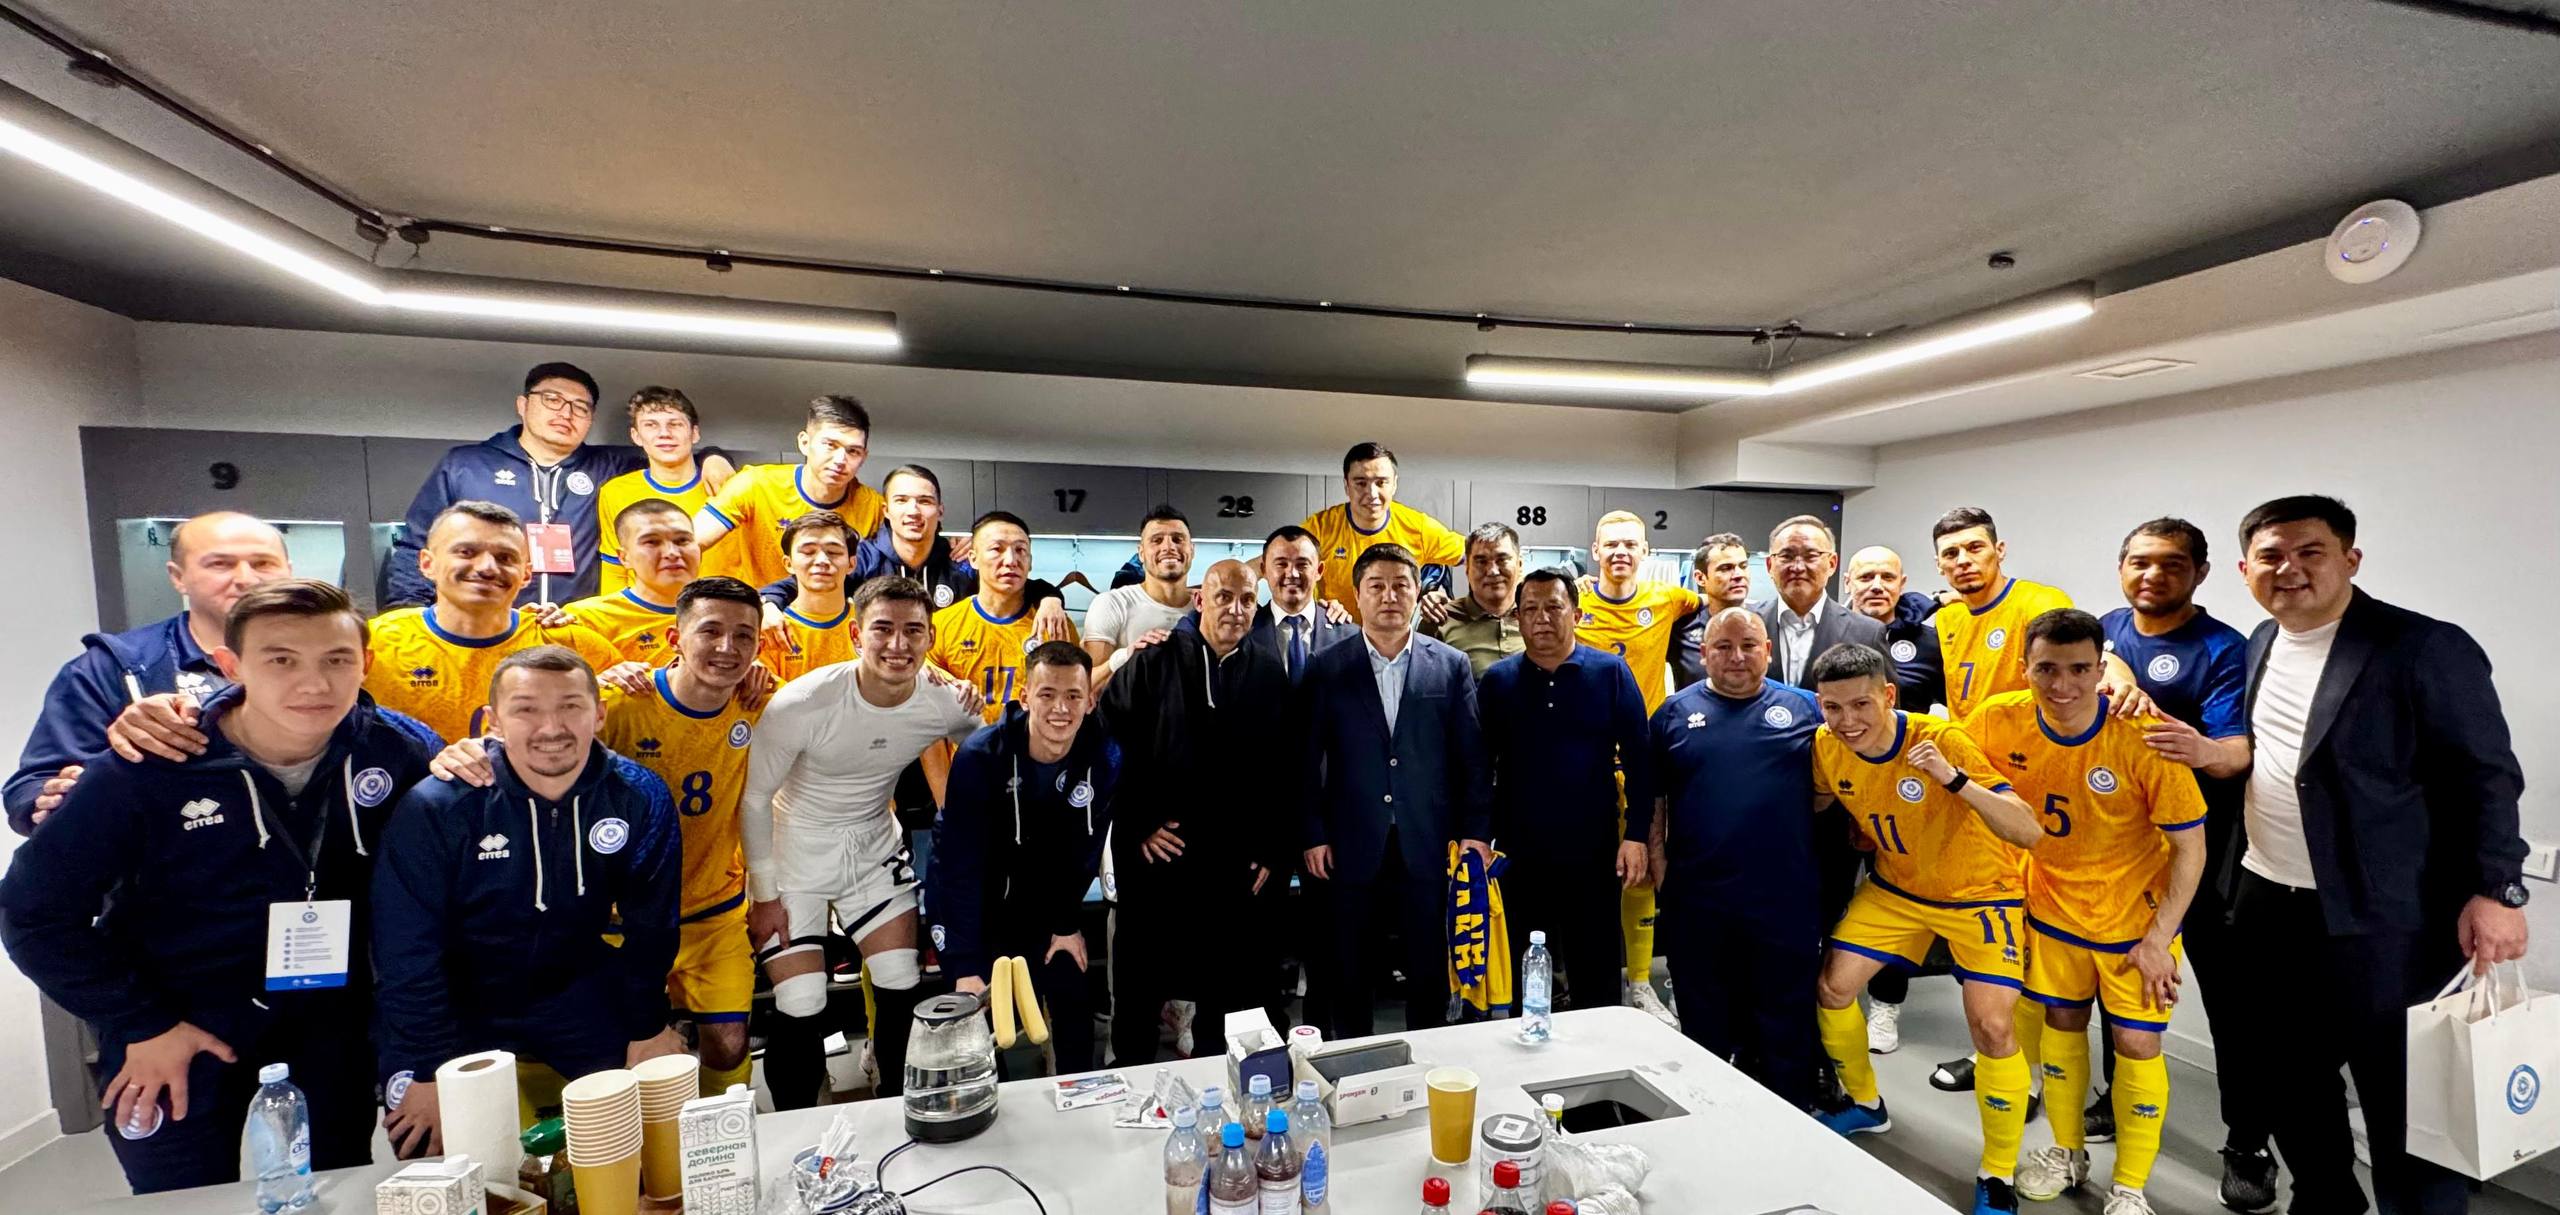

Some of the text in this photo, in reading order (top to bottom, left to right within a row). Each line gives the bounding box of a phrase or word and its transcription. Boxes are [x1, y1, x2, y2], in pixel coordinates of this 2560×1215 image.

[209, 462, 240, 490] 9
[1053, 489, 1087, 513] 17
[1216, 495, 1255, 518] 28
[1516, 505, 1547, 526] 88
[1653, 510, 1668, 530] 2
[983, 665, 1018, 705] 17
[1959, 662, 1976, 700] 7
[679, 769, 714, 817] 8
[2044, 792, 2072, 838] 5
[1868, 813, 1909, 855] 11
[477, 849, 511, 861] errea
[1973, 906, 2017, 948] 11
[686, 1141, 747, 1159] северная
[687, 1151, 736, 1169] долина
